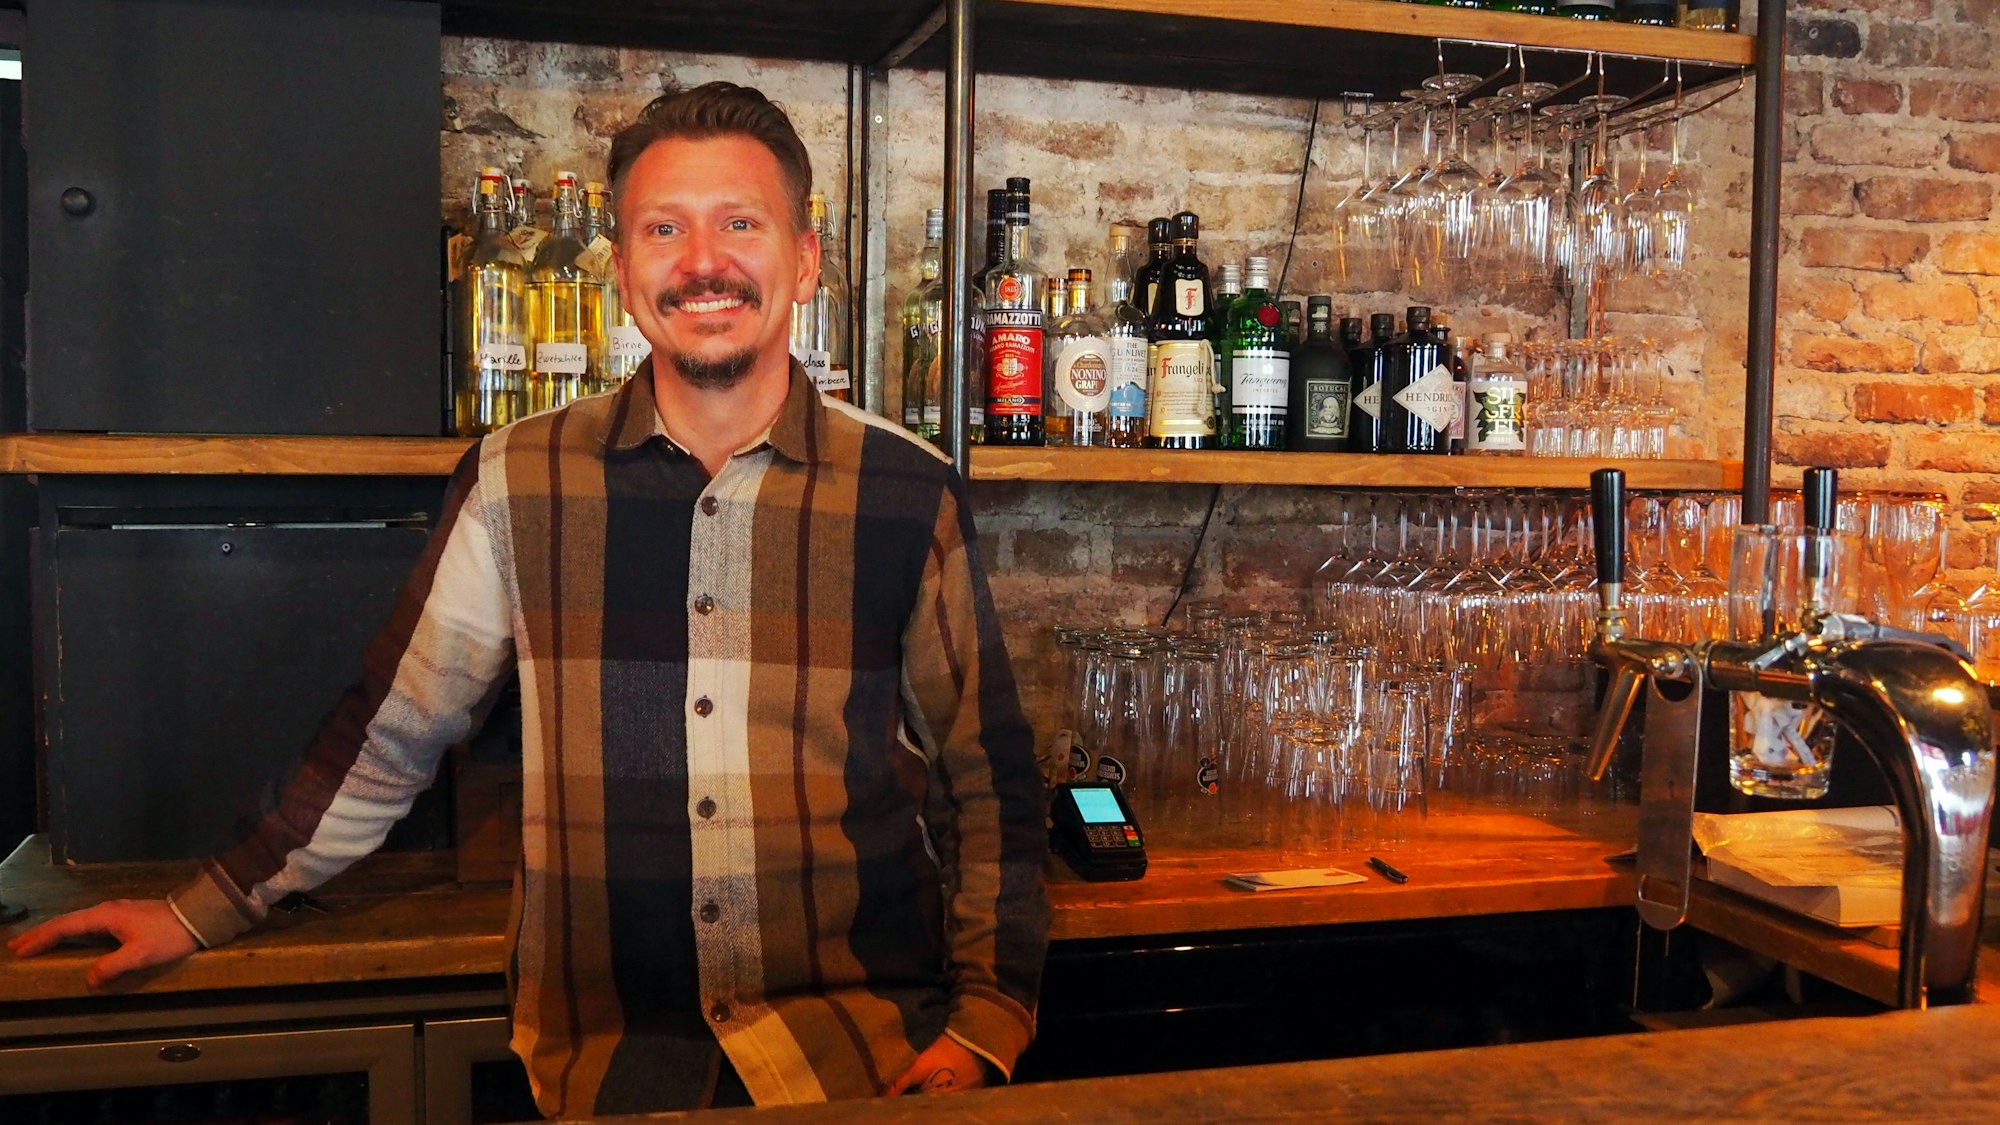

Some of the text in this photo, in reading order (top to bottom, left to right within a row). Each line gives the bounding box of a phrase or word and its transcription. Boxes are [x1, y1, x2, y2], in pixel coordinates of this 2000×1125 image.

[987, 312, 1041, 325] RAMAZZOTTI
[612, 337, 643, 350] Birne
[992, 333, 1031, 345] AMARO
[1161, 357, 1211, 378] Frangeli
[1071, 368, 1107, 380] NONINO
[1075, 380, 1098, 390] GRAP
